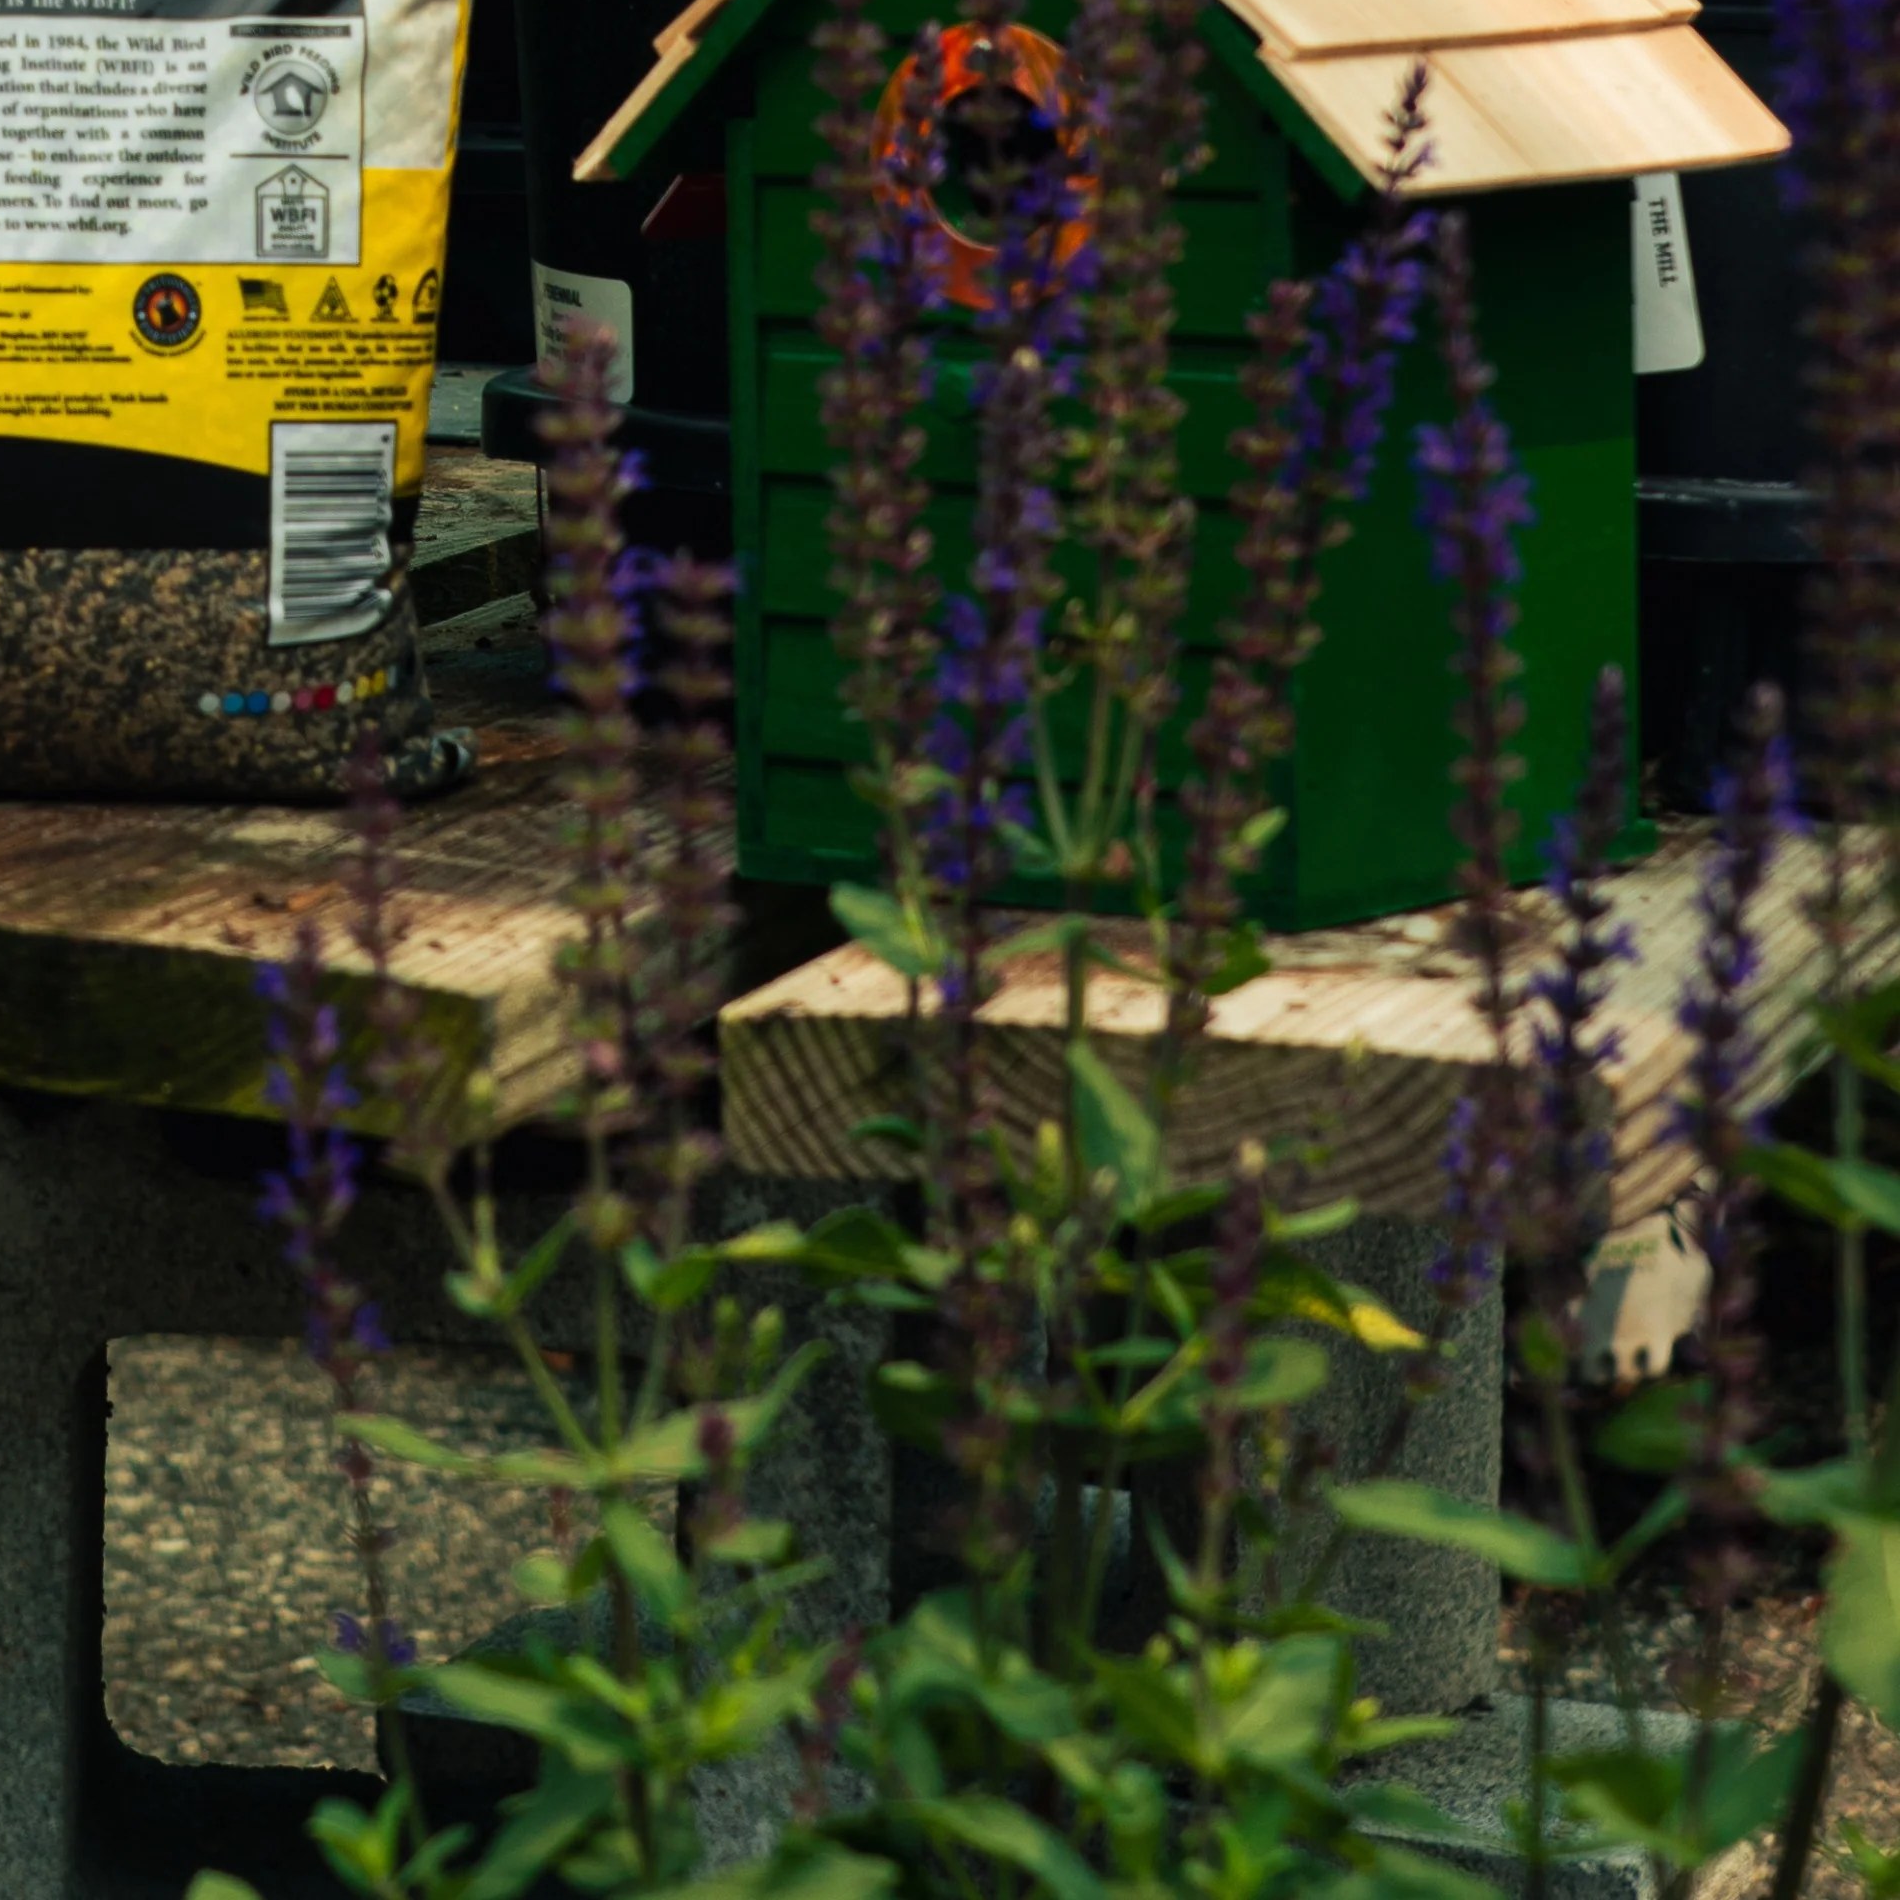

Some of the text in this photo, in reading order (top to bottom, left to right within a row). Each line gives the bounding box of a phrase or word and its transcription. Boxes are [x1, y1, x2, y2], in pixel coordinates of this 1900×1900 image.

[25, 34, 40, 49] in
[48, 34, 89, 51] 1984,
[96, 35, 119, 52] the
[128, 36, 164, 52] Wild
[172, 36, 206, 51] Bird
[263, 43, 293, 59] BIRD
[21, 56, 87, 73] Institute
[96, 58, 155, 76] (WBFI)
[166, 60, 177, 73] is
[188, 61, 207, 73] an
[39, 81, 69, 95] that
[74, 81, 137, 96] includes
[153, 81, 207, 95] diverse
[2, 101, 18, 116] of
[24, 104, 129, 120] organizations
[135, 103, 168, 118] who
[173, 103, 206, 118] have
[2, 126, 66, 143] together
[76, 126, 110, 141] with
[140, 129, 205, 141] common
[31, 149, 47, 163] to
[50, 149, 114, 164] enhance
[119, 148, 142, 163] the
[146, 149, 206, 164] outdoor
[4, 171, 62, 190] feeding
[82, 172, 163, 190] experience
[184, 171, 207, 186] for
[42, 194, 62, 209] To
[69, 194, 100, 209] find
[106, 196, 130, 209] out
[137, 198, 182, 211] more,
[189, 198, 208, 213] go
[270, 207, 316, 223] WBFI
[5, 218, 21, 231] to
[1648, 197, 1679, 289] THE MILL
